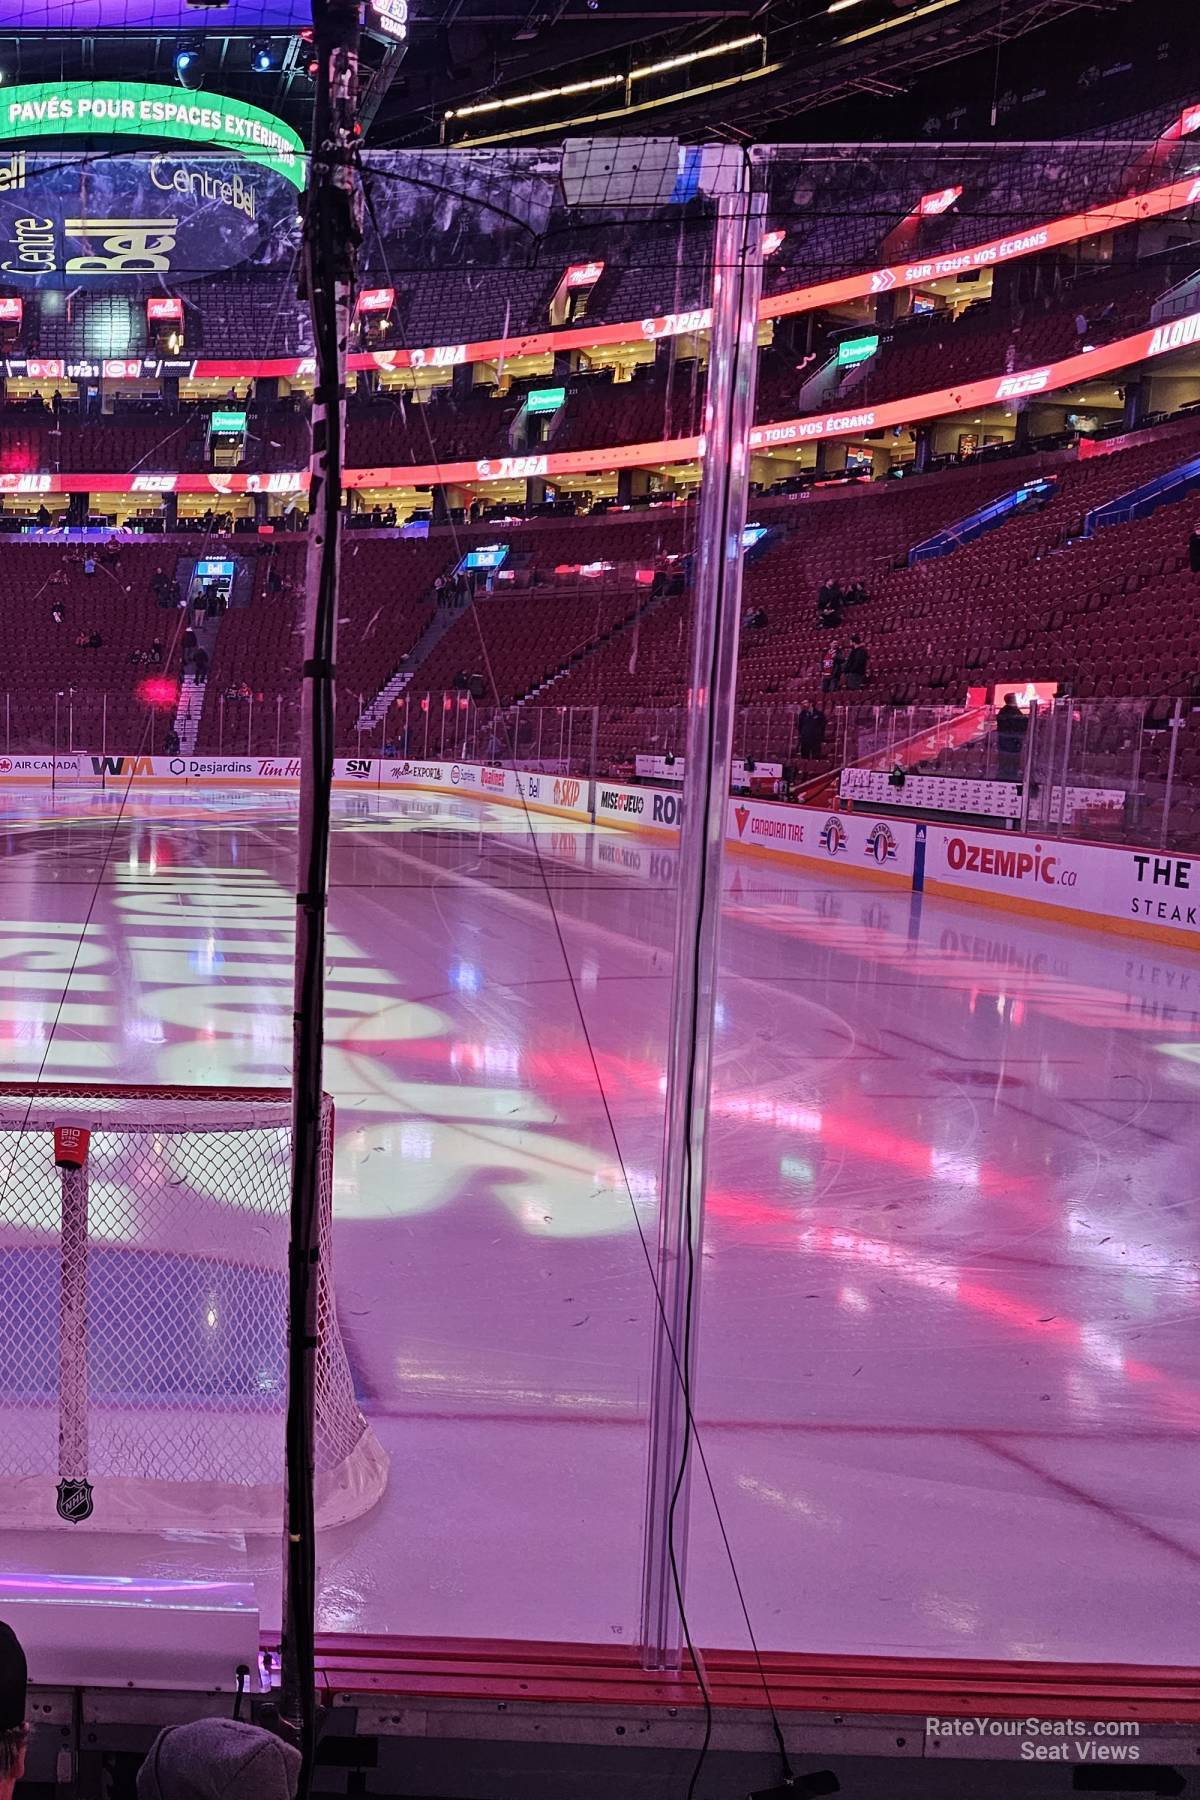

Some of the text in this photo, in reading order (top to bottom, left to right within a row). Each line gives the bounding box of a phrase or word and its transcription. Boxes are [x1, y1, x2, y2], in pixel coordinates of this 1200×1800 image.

[8, 96, 73, 122] PAVÉS
[77, 99, 135, 118] POUR
[140, 100, 222, 130] ESPACES
[1, 219, 178, 274] Centre Bell
[905, 231, 1048, 280] SUR TOUS VOS ÉCRANS
[432, 345, 467, 365] NBA
[67, 366, 99, 377] 17:21
[765, 427, 796, 441] TOUS
[799, 423, 823, 436] VOS
[826, 413, 875, 433] ÉCRANS
[268, 474, 300, 491] NBA
[208, 562, 223, 573] Bell
[15, 761, 78, 770] AIR CANADA
[91, 757, 154, 775] WM
[190, 761, 252, 776] Desjardins
[257, 759, 283, 776] Tim
[346, 760, 372, 773] SN
[529, 777, 541, 798] Bell
[562, 780, 580, 807] SKIP
[751, 818, 805, 842] CANADIAN TIRE
[1133, 855, 1192, 889] THE
[1131, 897, 1197, 924] STEAK
[61, 1128, 80, 1137] BIO
[65, 1491, 85, 1513] NHL
